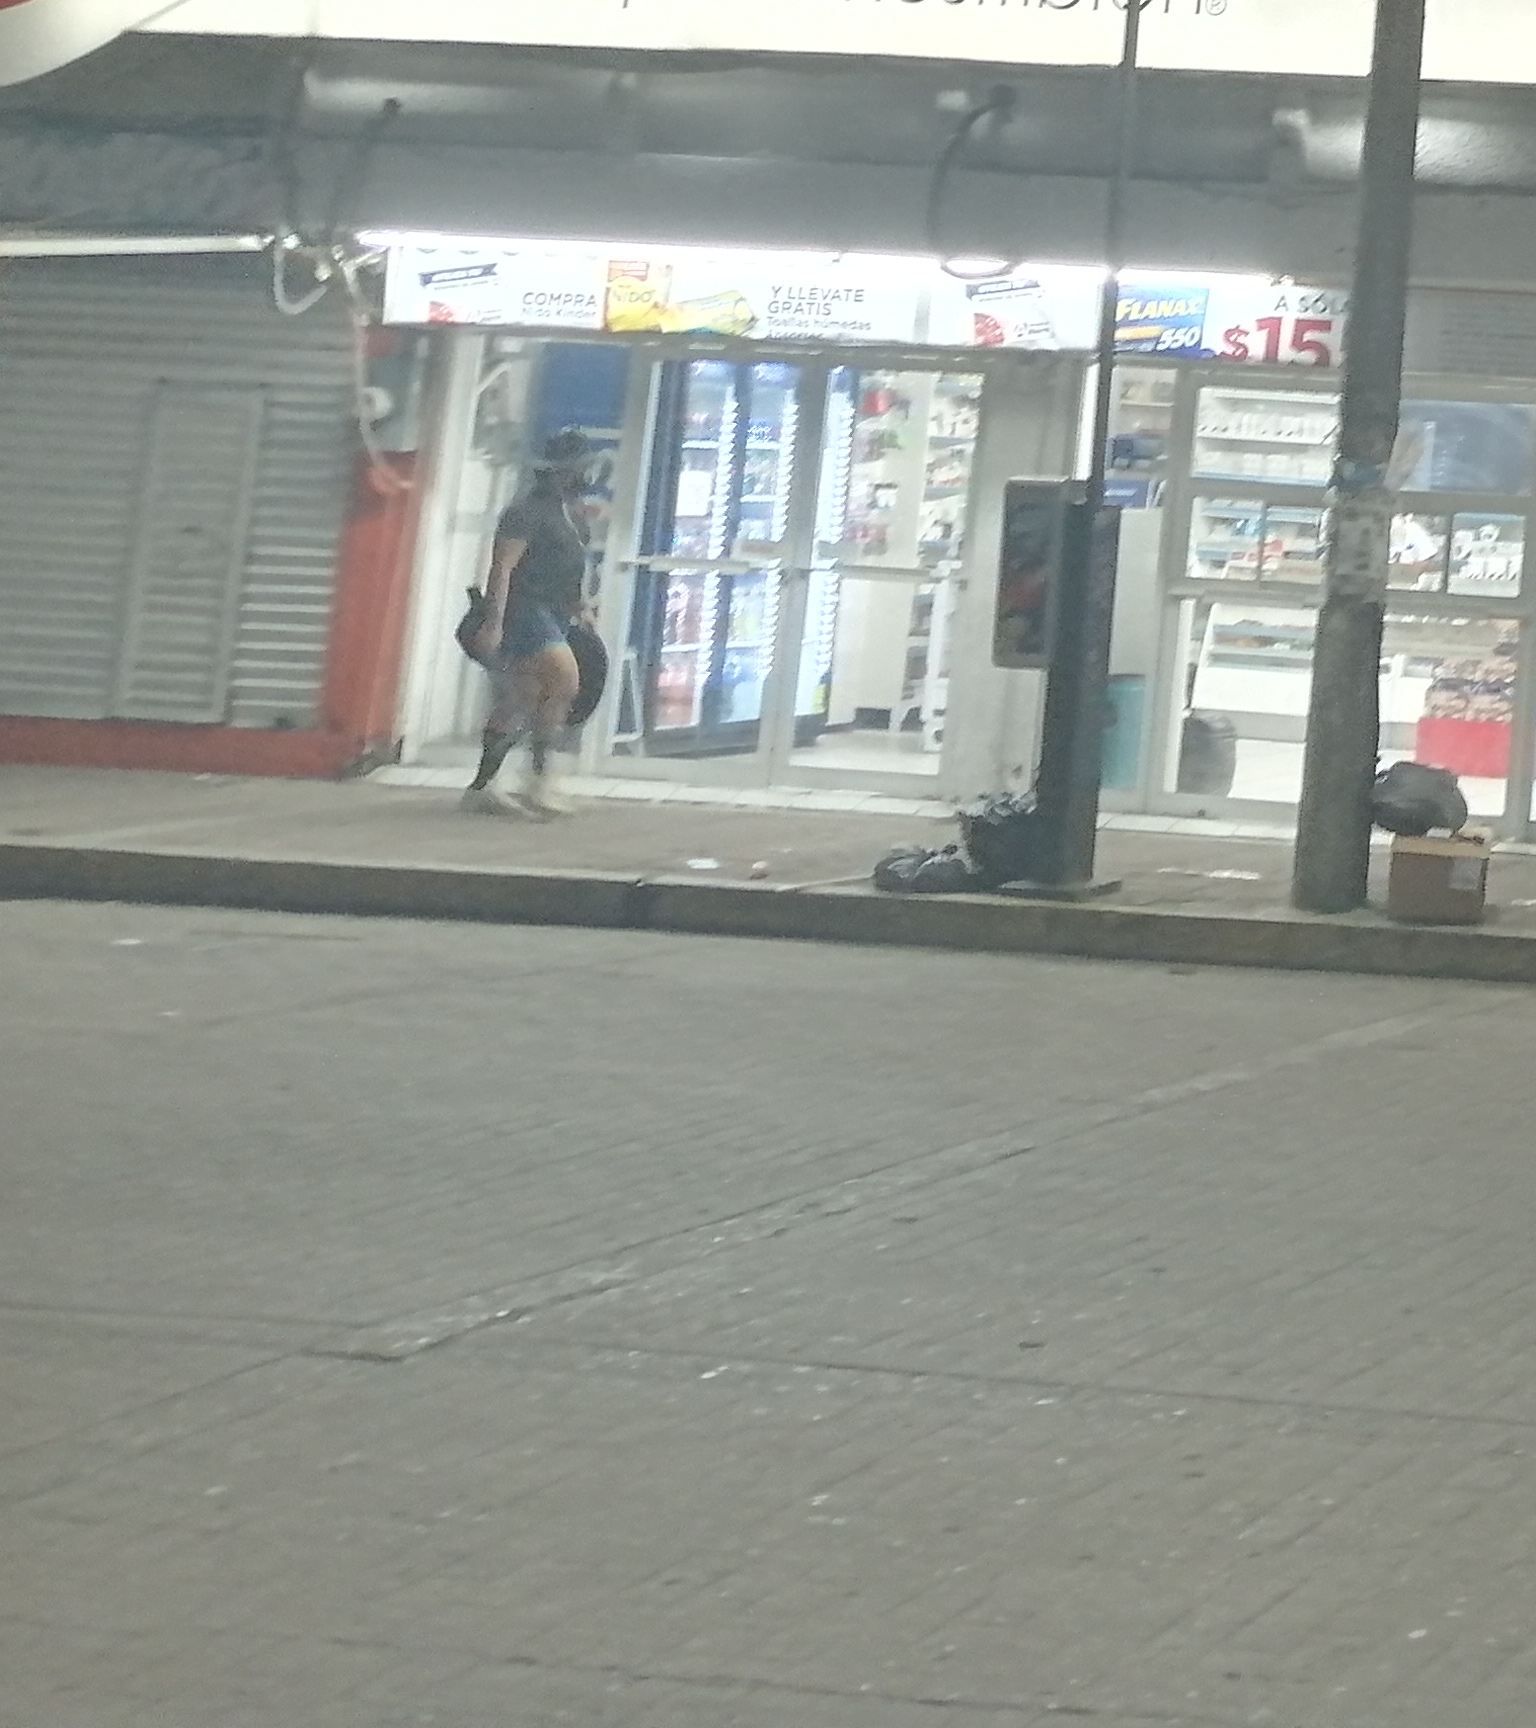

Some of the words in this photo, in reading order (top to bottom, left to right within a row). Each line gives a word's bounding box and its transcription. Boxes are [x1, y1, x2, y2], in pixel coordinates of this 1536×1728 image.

[522, 292, 598, 307] COMPRA
[771, 285, 783, 299] Y
[767, 300, 832, 316] GRATIS
[1115, 298, 1205, 322] FLANAX
[1274, 295, 1289, 311] A
[1157, 326, 1201, 351] 550
[1222, 316, 1332, 366] $15
